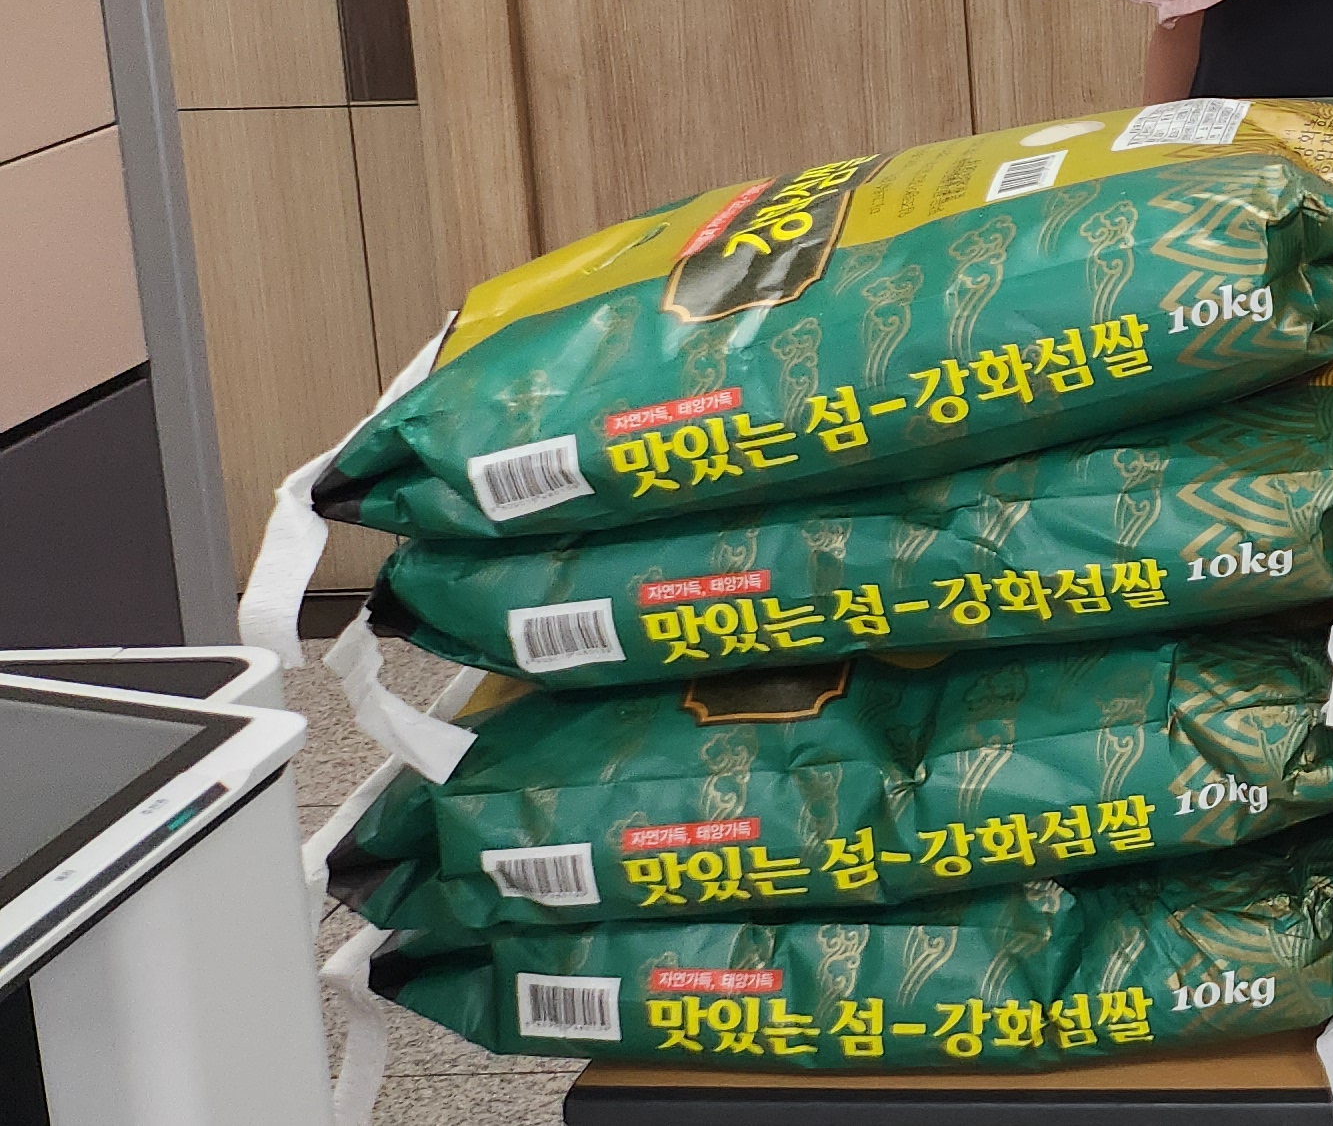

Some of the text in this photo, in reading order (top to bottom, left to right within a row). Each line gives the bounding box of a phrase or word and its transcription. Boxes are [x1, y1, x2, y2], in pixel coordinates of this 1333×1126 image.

[607, 283, 1274, 498] 맛있는 섬-강화섬쌀 10kg
[641, 541, 1294, 664] 맛있는 섬-강화섬쌀 10kg
[622, 773, 1269, 908] 맛있는 섬-강화섬쌀 10kg
[646, 970, 1277, 1058] 맛있는 섬-강화섬쌀 10kg
